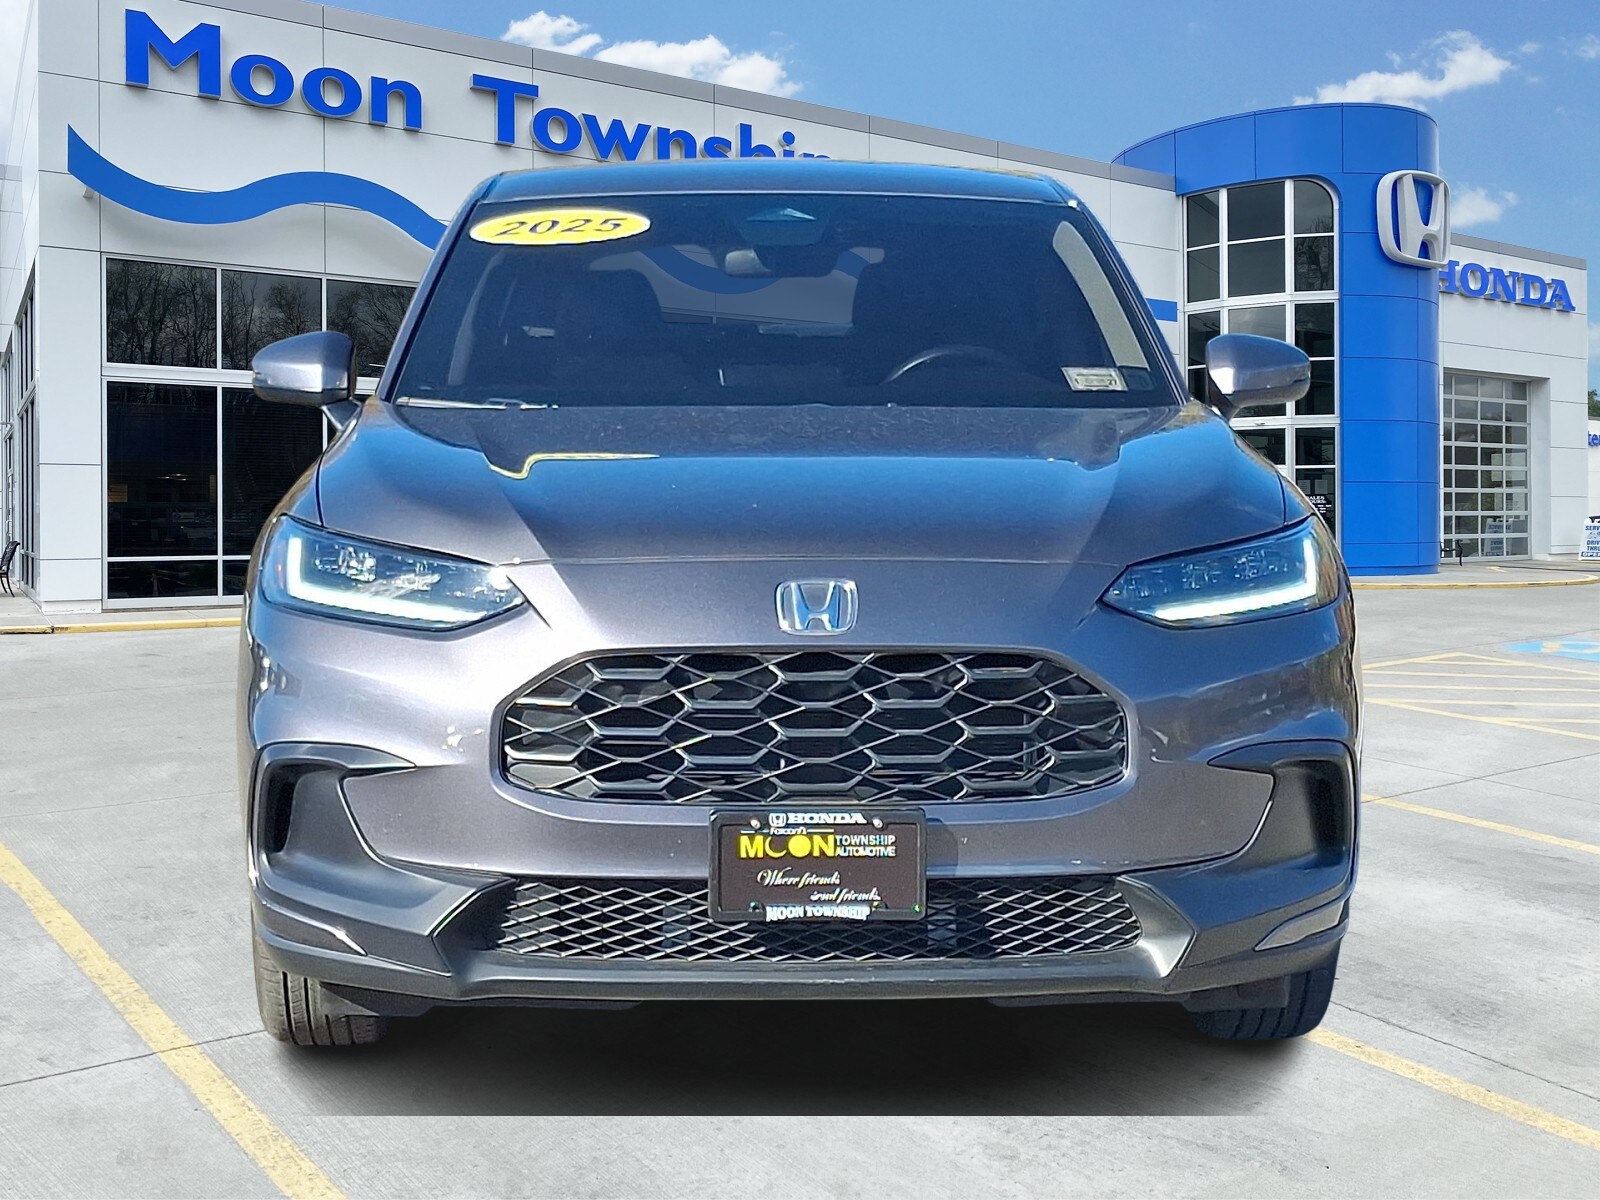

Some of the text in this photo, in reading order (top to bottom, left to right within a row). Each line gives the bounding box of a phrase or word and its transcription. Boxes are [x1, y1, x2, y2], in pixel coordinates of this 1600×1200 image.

[125, 9, 832, 162] Moon Townshi
[492, 217, 628, 238] 2025
[1438, 259, 1576, 312] HONDA
[1588, 430, 1600, 447] te
[786, 812, 868, 824] HONDA
[835, 835, 897, 846] TOWNSHIP
[835, 846, 897, 857] AUTOMOTIVE
[757, 867, 799, 886] Where
[766, 904, 871, 922] MOON TOWNSHIP
